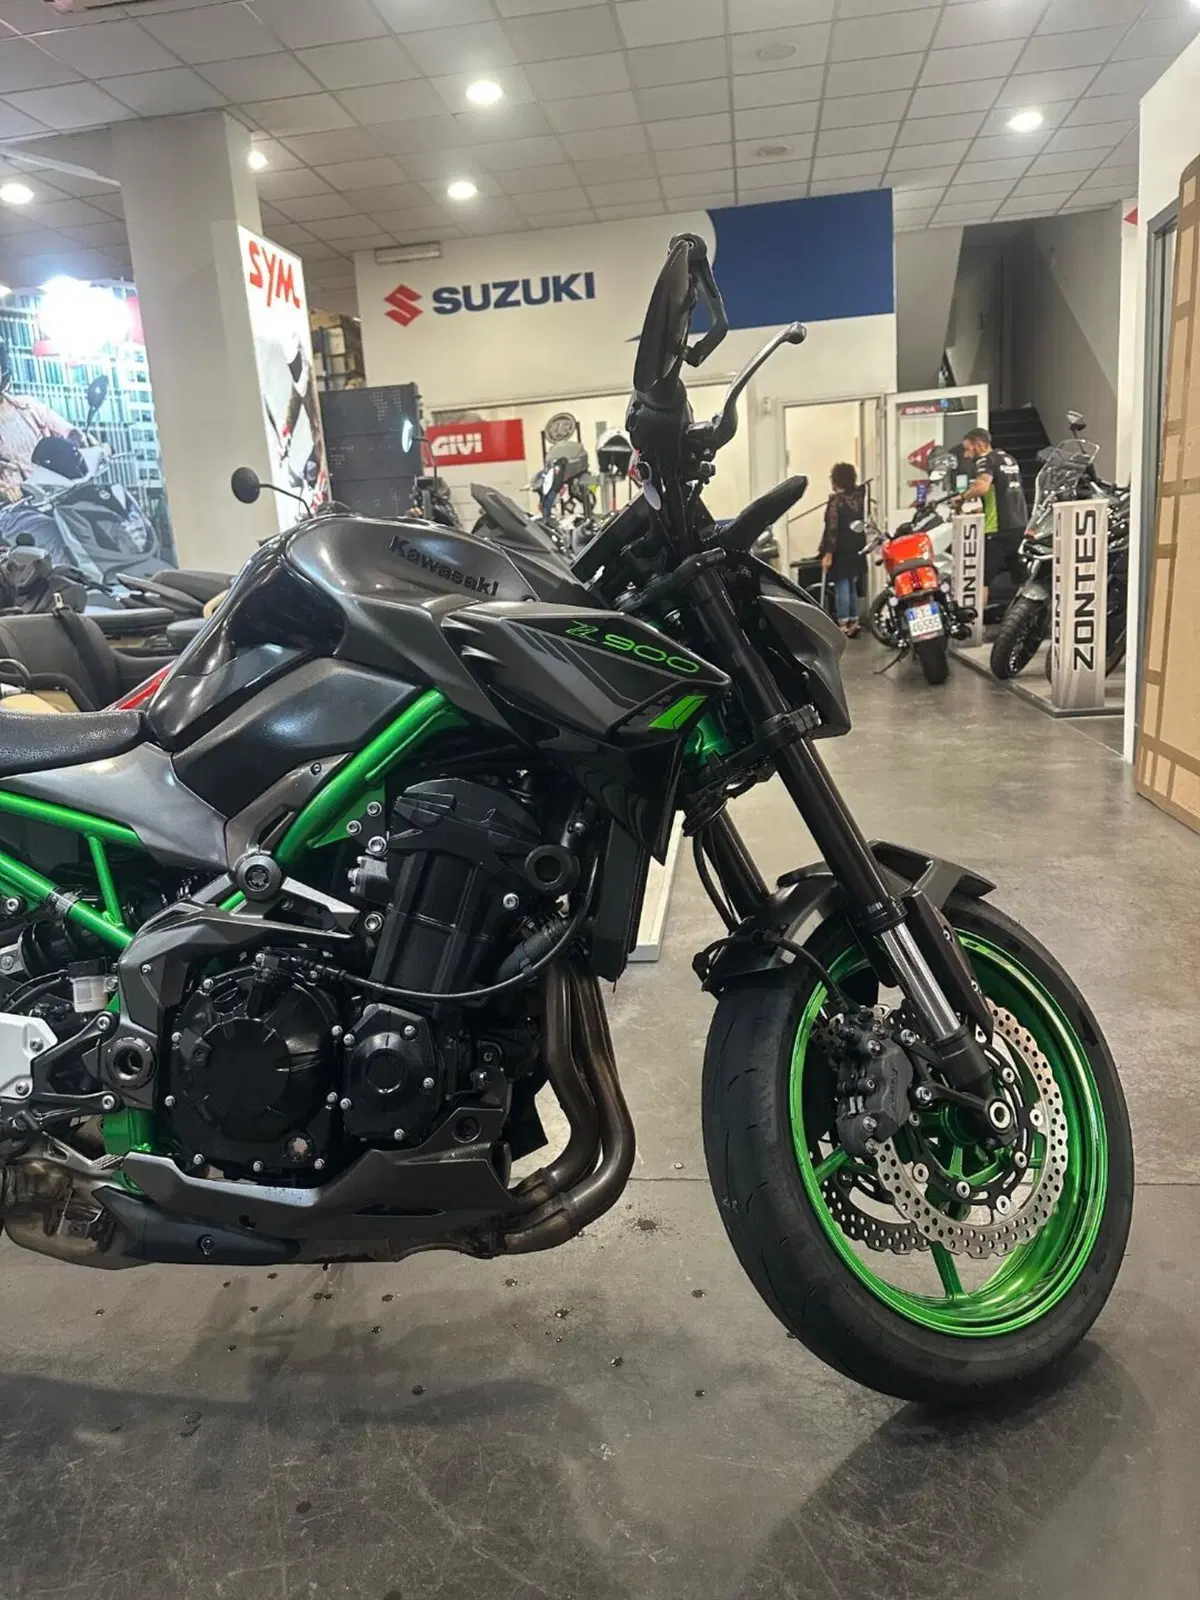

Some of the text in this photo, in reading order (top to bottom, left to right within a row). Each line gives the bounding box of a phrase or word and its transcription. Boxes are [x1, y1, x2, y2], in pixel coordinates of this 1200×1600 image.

[248, 240, 301, 309] SYM
[432, 272, 596, 315] SUZUKI
[431, 432, 484, 457] GIVI
[389, 535, 499, 596] Kawasaki
[963, 523, 977, 608] ONTES
[1074, 509, 1097, 670] ZONTES
[602, 633, 700, 672] 900
